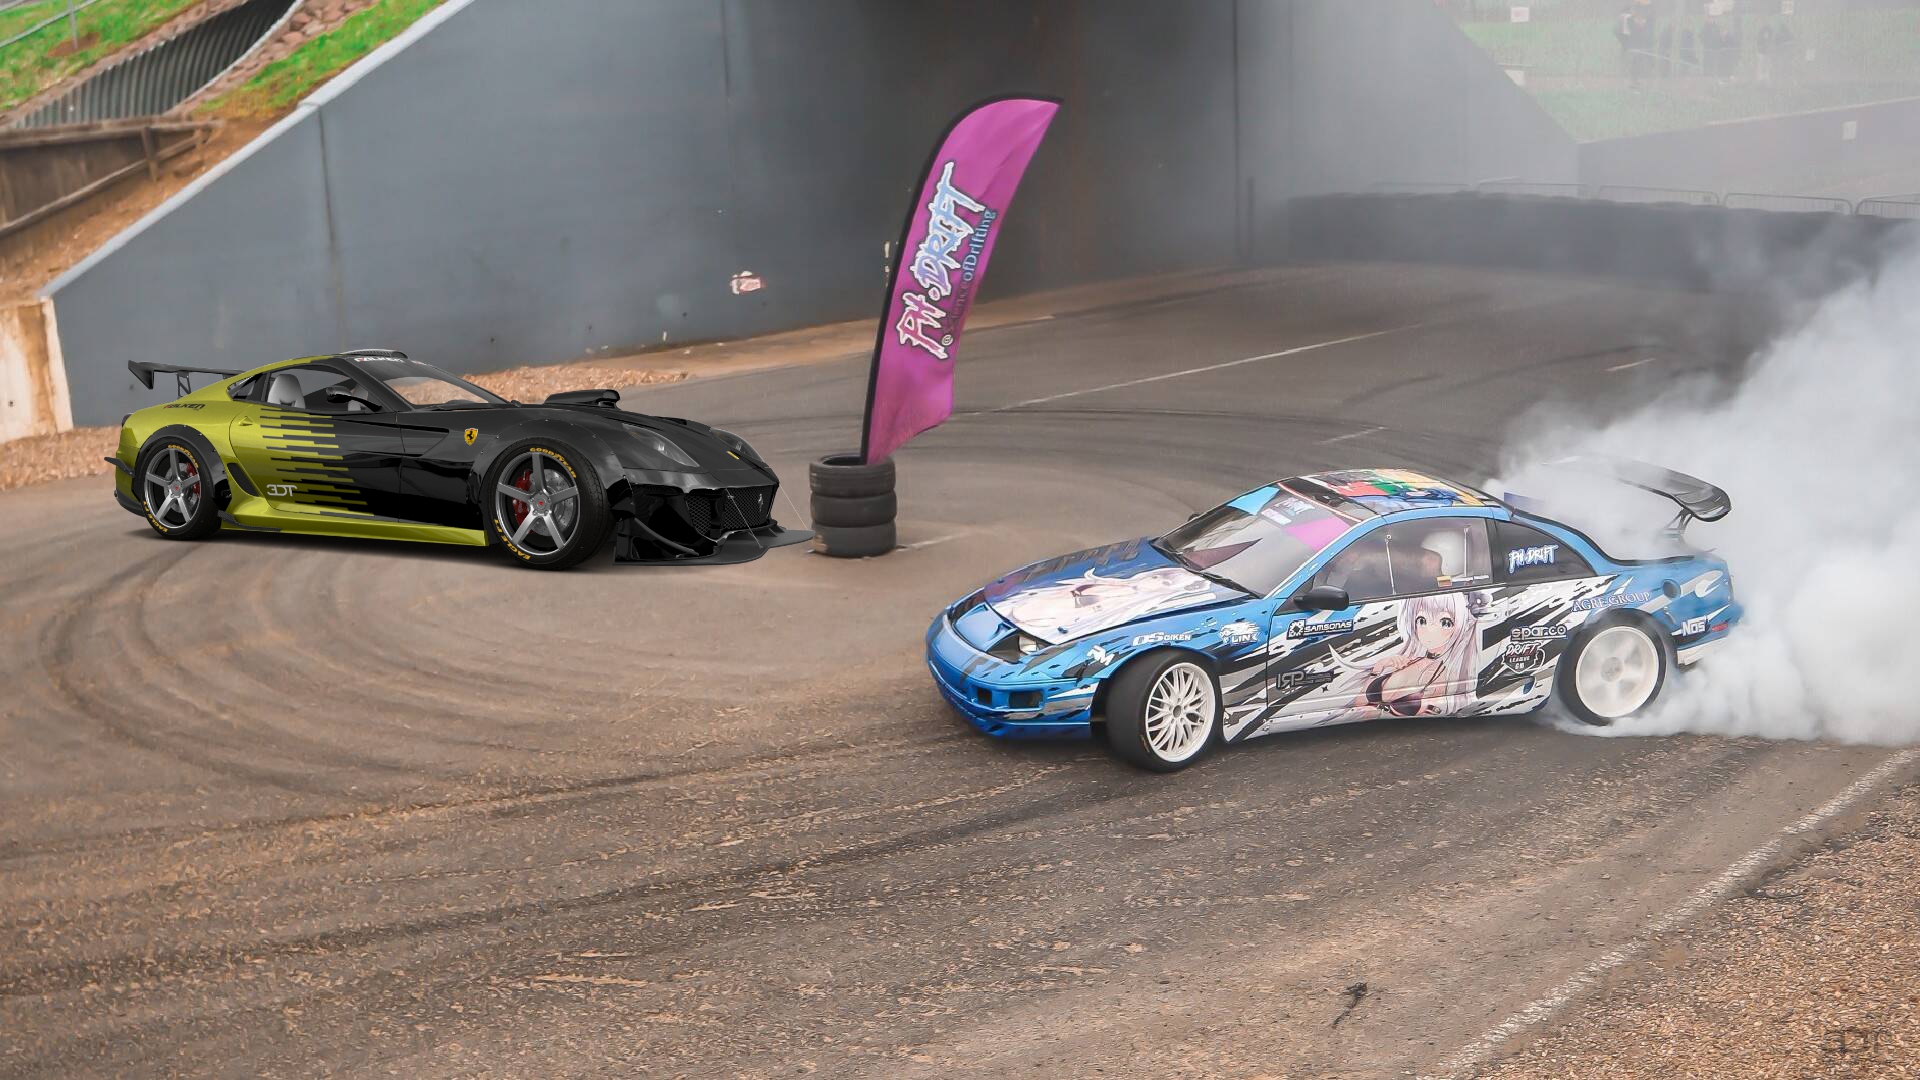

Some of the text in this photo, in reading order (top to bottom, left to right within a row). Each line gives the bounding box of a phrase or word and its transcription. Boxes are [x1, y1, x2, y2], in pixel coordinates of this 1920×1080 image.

[529, 447, 577, 479] GOODYEAR
[501, 535, 531, 560] EAGLE
[1608, 592, 1650, 606] GROUP
[1303, 621, 1353, 632] SAMSONAS
[1682, 621, 1706, 637] NOS
